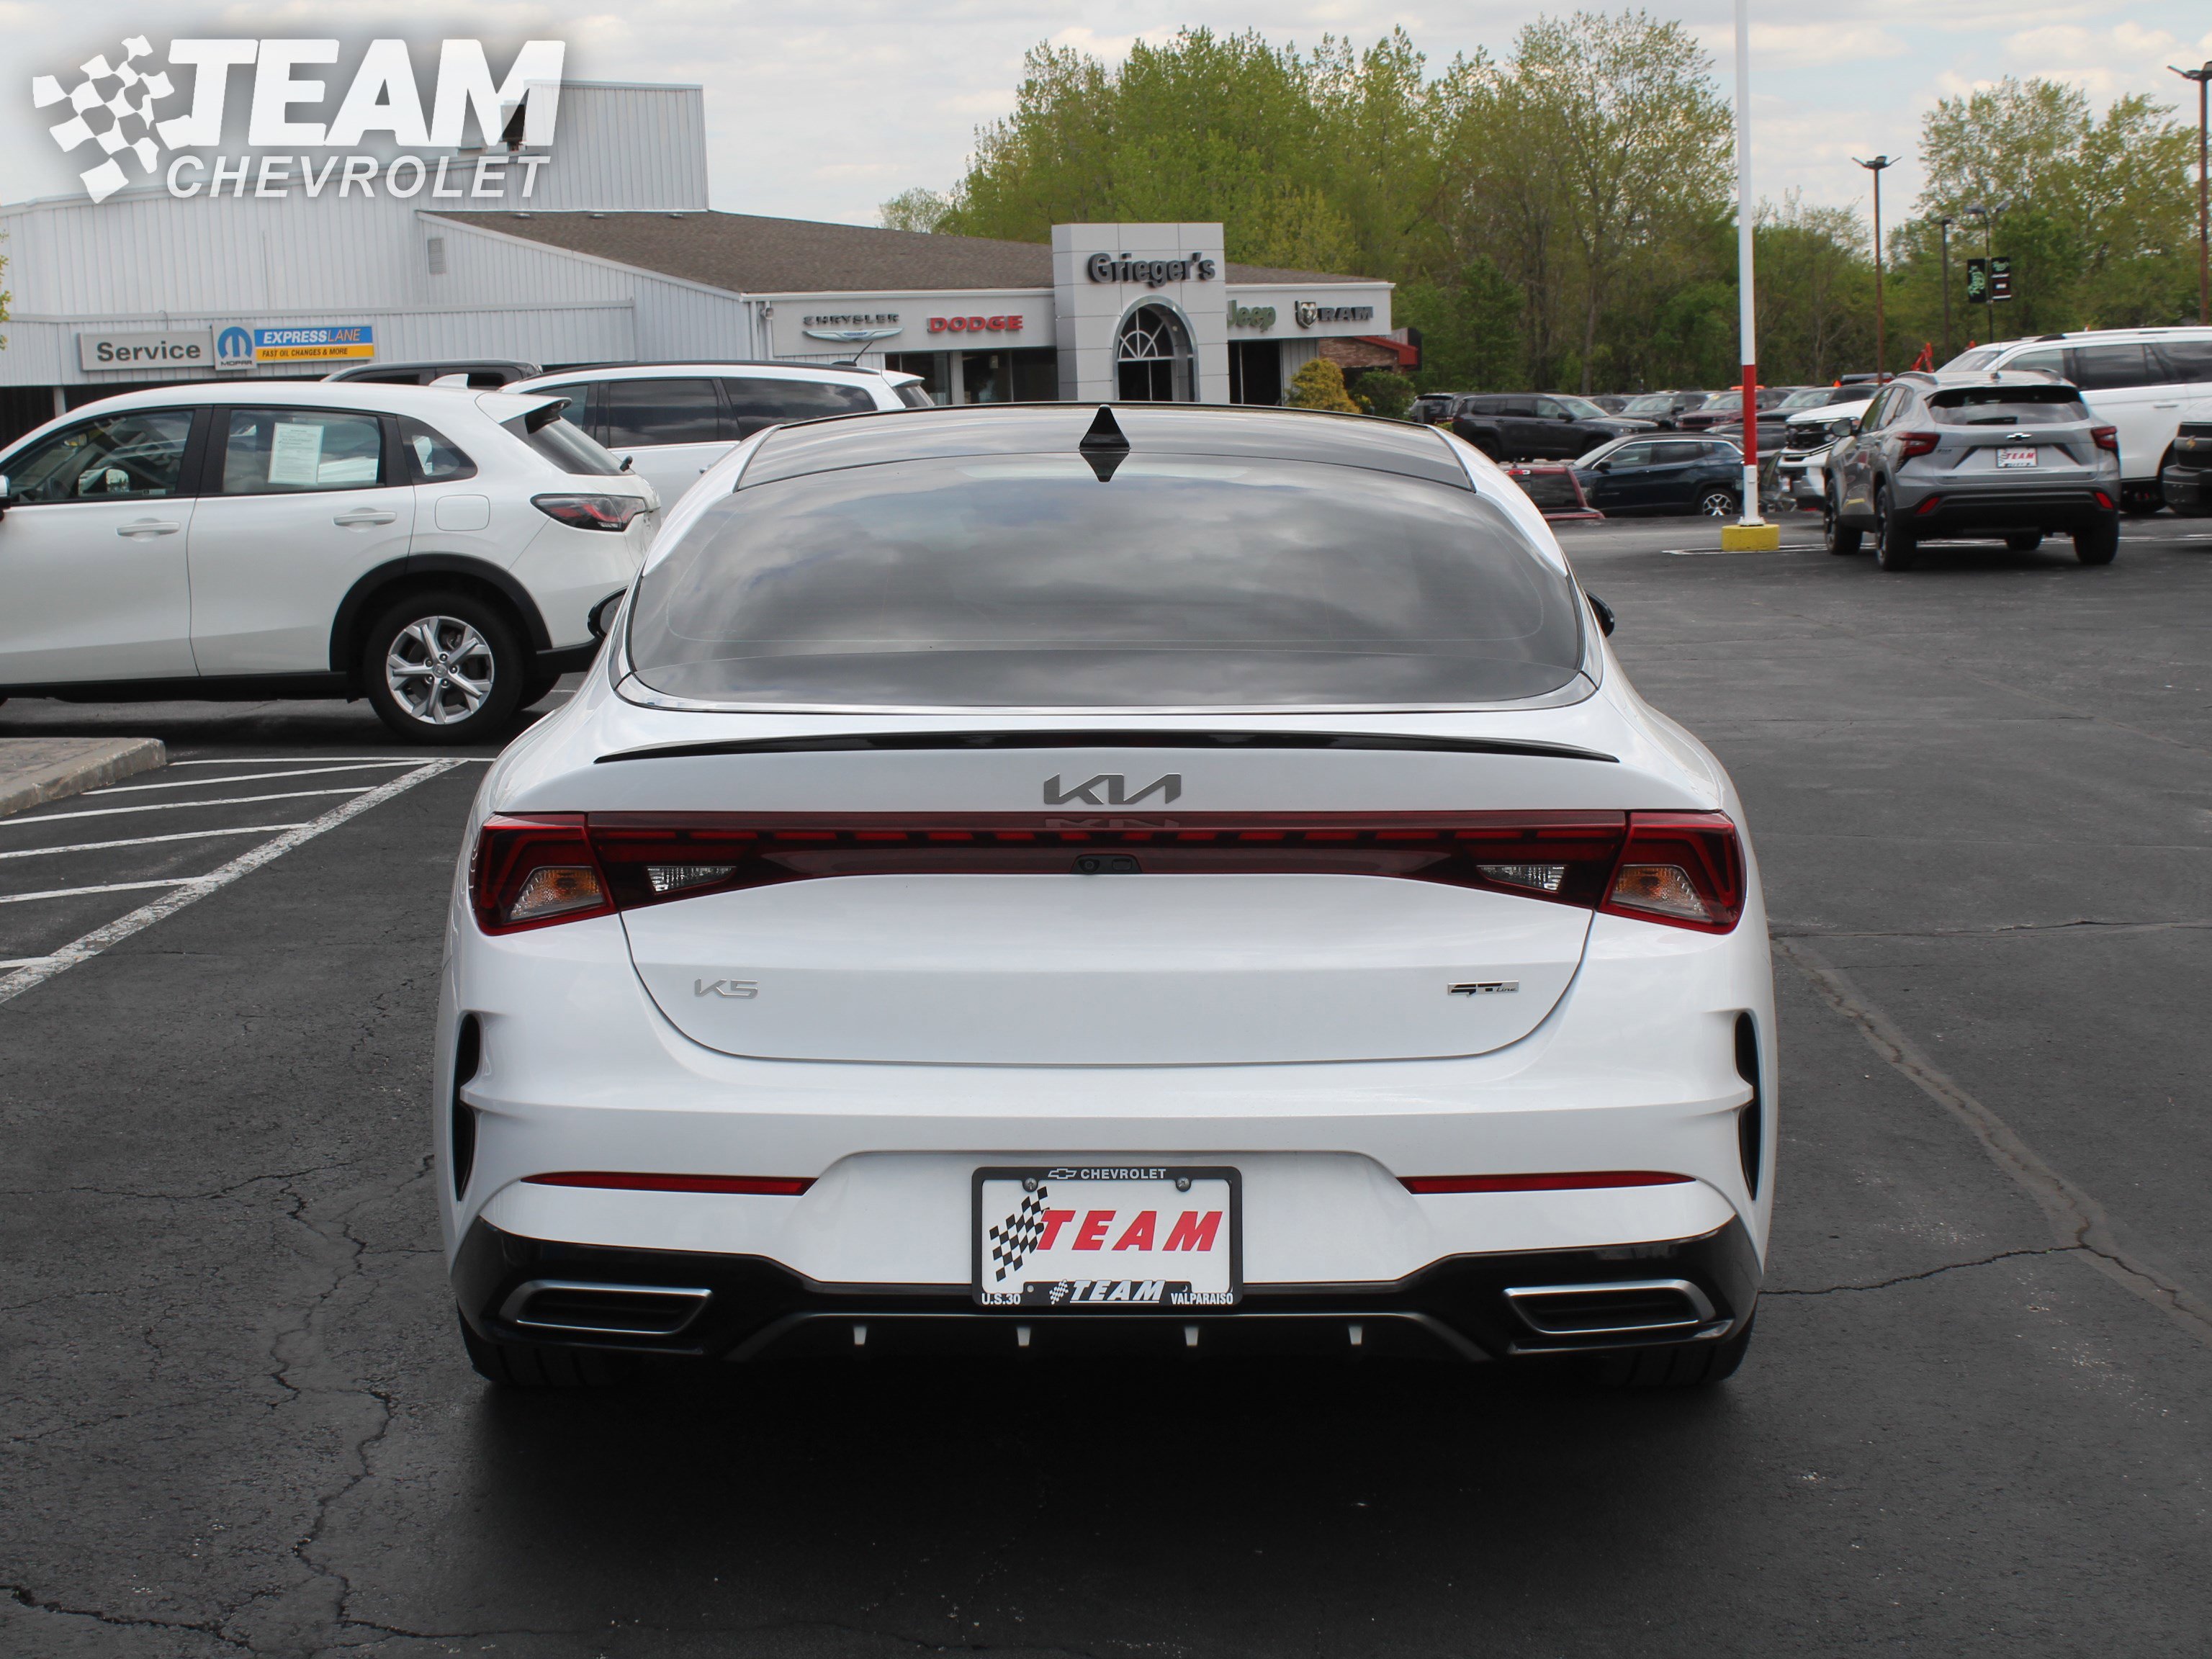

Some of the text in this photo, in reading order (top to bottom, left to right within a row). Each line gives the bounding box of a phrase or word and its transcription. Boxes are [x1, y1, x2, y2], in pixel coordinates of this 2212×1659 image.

[1088, 251, 1216, 288] Grieger's
[803, 314, 899, 325] CHRYSLER
[927, 315, 1023, 333] DODGE
[1227, 300, 1277, 332] Jeep
[1317, 307, 1373, 321] RAM
[96, 341, 201, 362] Service
[291, 348, 321, 356] CHANGES
[1043, 773, 1182, 805] KIA
[694, 978, 758, 999] K5
[1080, 1169, 1166, 1179] CHEVROLET
[1035, 1210, 1223, 1251] TEAM
[1071, 1280, 1166, 1301] TEAM
[1171, 1292, 1234, 1305] VALPARAISO
